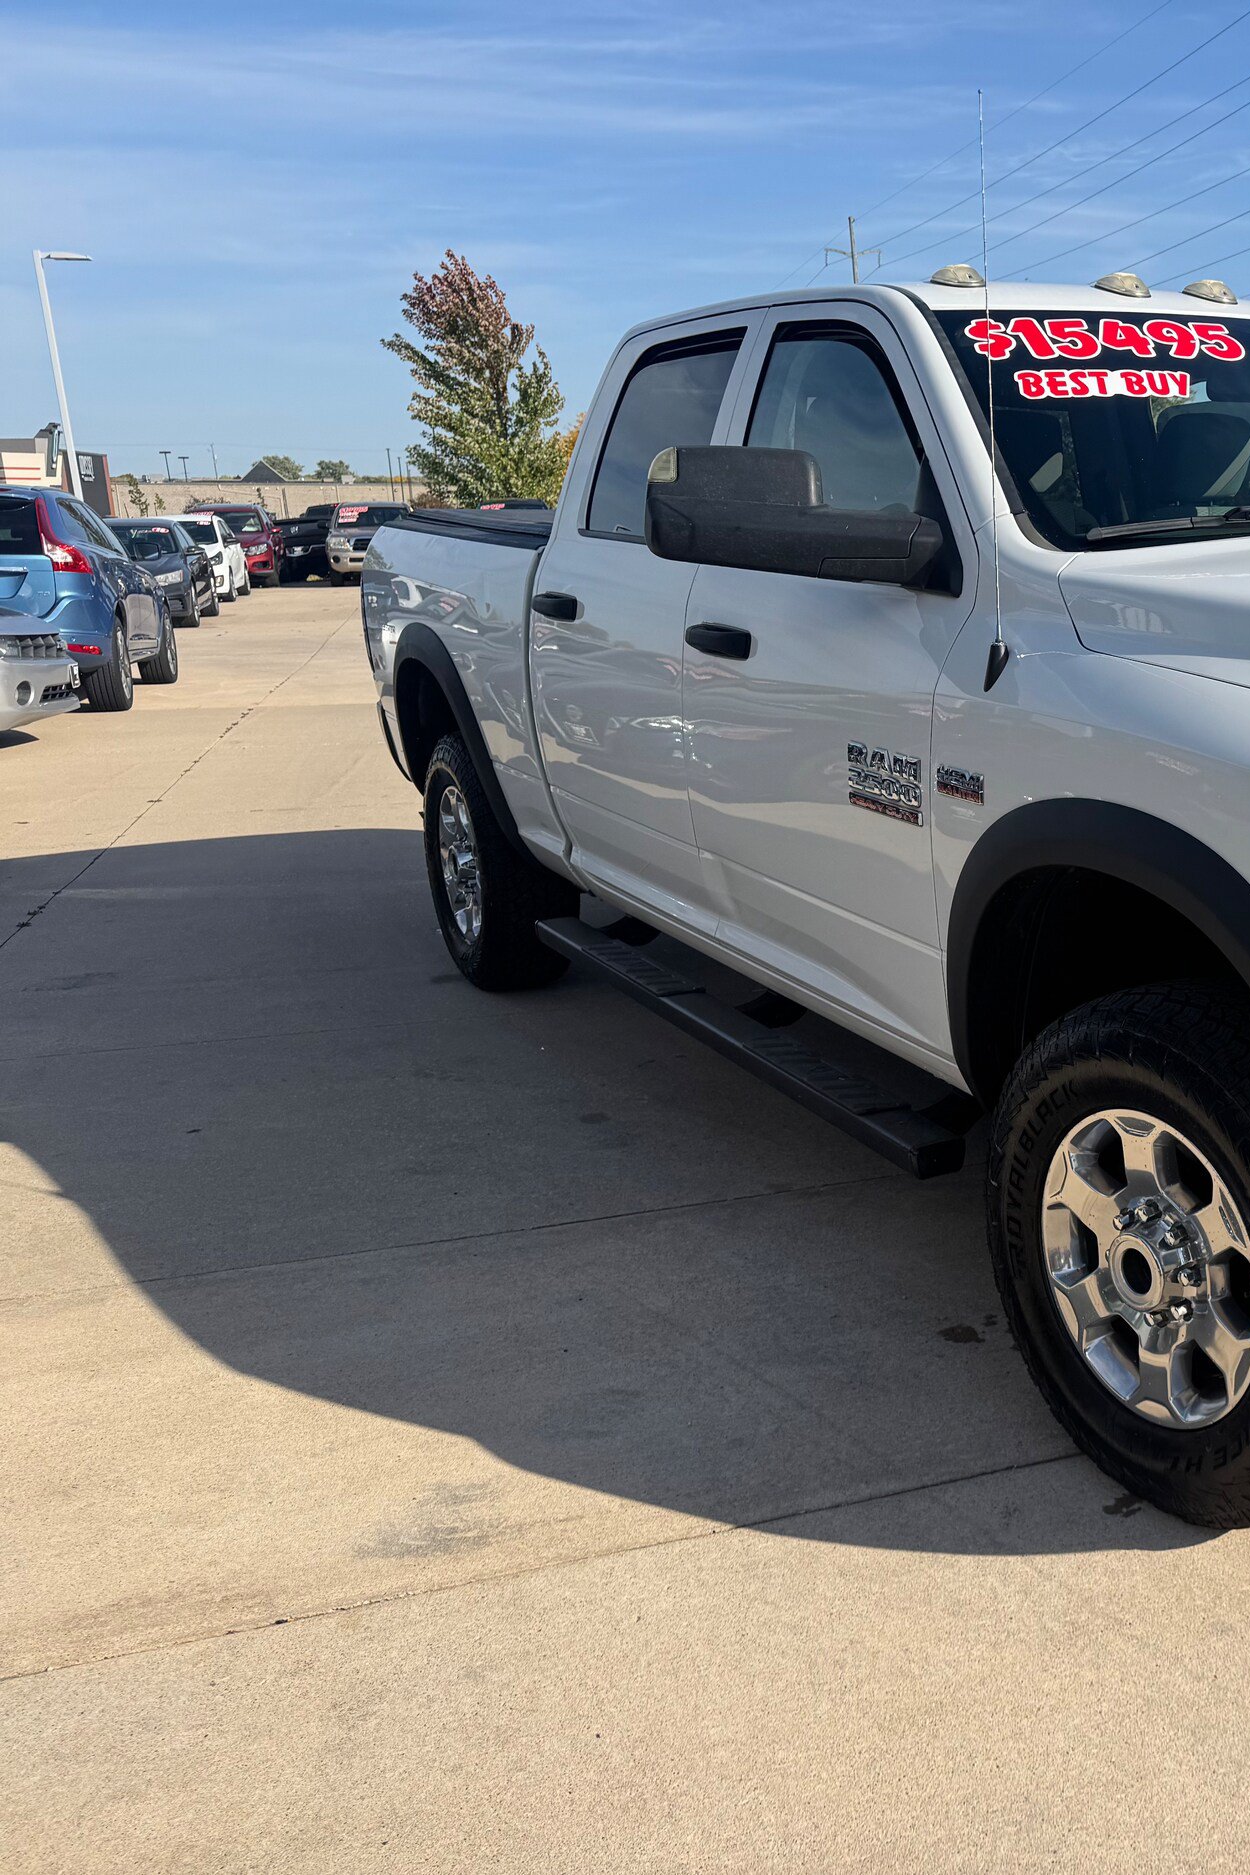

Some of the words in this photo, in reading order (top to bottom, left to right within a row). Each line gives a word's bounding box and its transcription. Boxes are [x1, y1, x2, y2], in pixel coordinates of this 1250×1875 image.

[964, 317, 1246, 361] $15495
[1014, 369, 1109, 399] BEST
[1120, 369, 1190, 398] BUY
[847, 740, 921, 783] RAM
[848, 766, 923, 809] 2500
